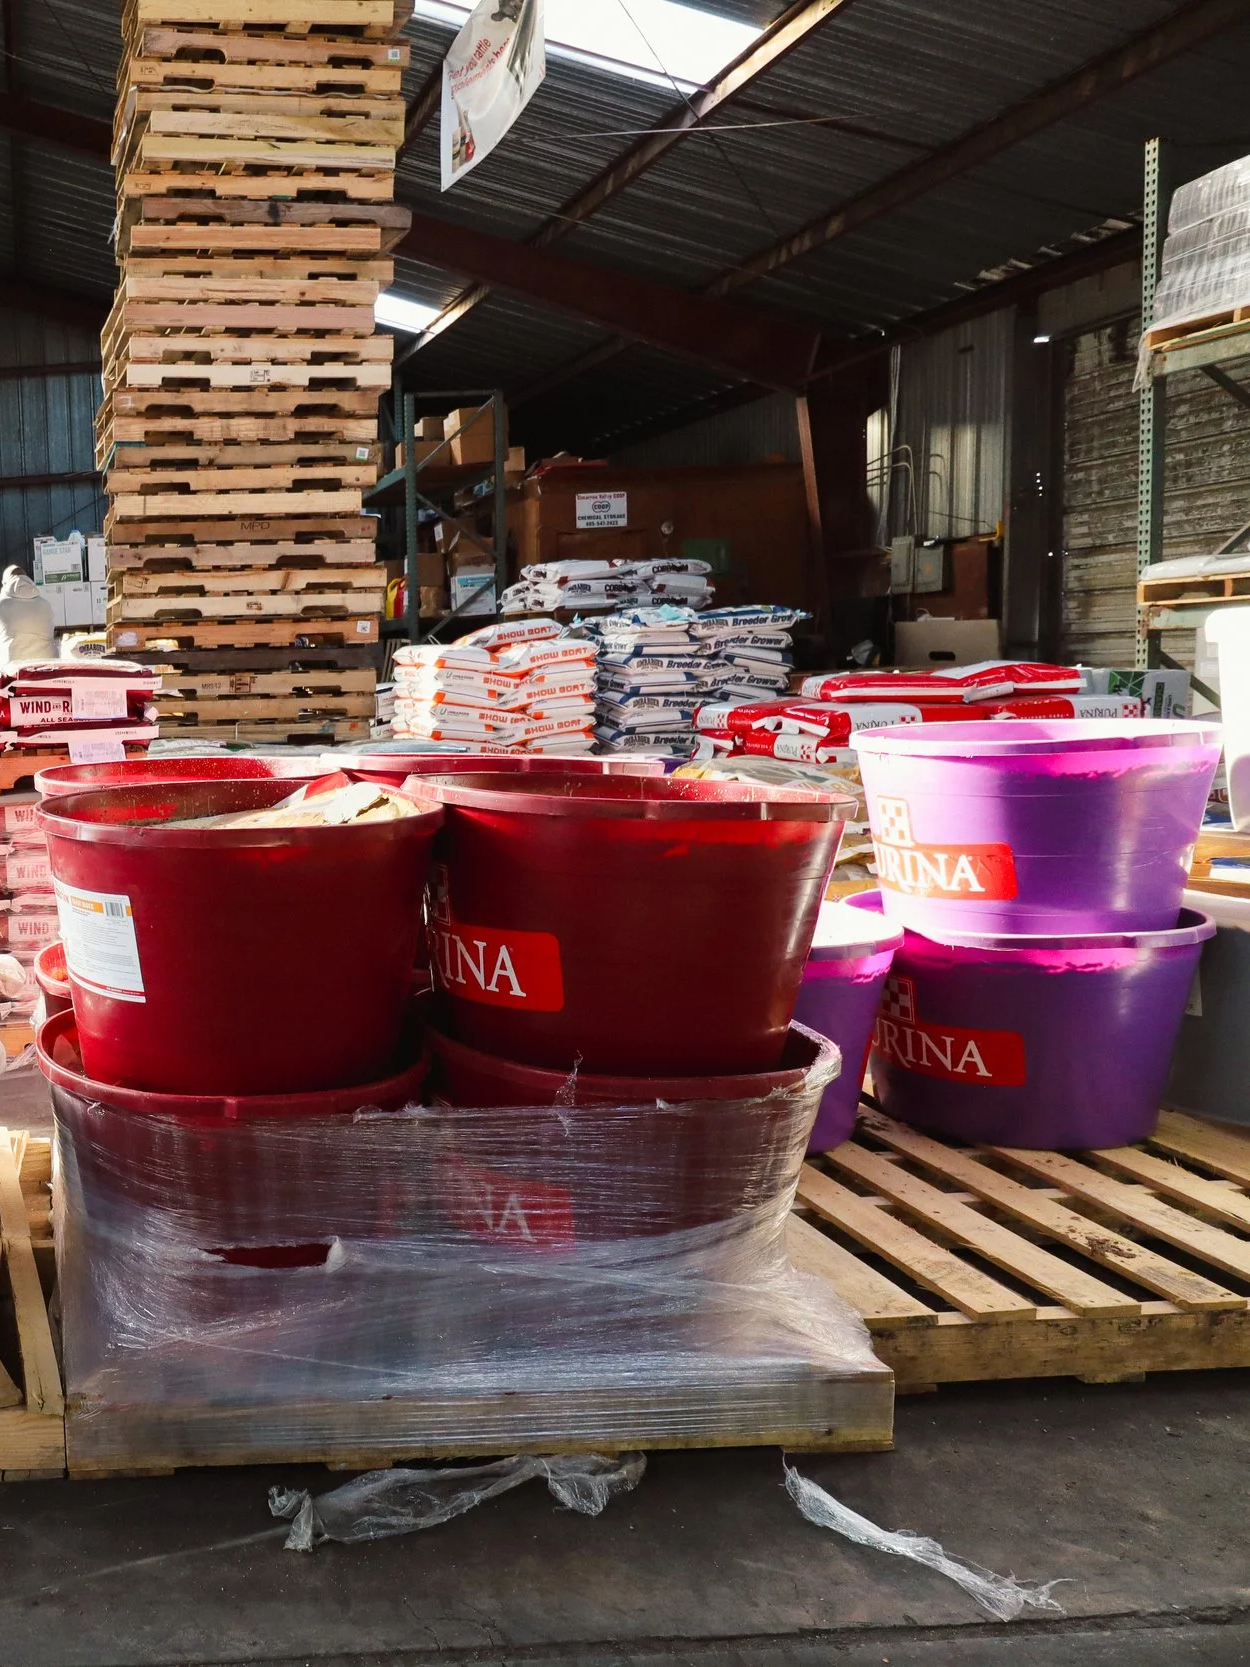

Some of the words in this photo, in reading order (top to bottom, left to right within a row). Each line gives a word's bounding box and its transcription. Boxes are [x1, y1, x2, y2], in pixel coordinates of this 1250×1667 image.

[732, 616, 768, 627] Breeder
[497, 629, 525, 641] SHOW
[528, 625, 552, 636] GOAT
[751, 636, 784, 646] Grower
[530, 651, 558, 663] SHOW
[561, 646, 588, 657] GOAT
[666, 659, 701, 669] Breeder
[483, 676, 511, 689] SHOW
[747, 675, 779, 687] Grower
[526, 686, 556, 699] SHOW
[559, 683, 586, 693] GOAT
[20, 700, 52, 714] WIND
[662, 698, 697, 709] Breeder
[479, 712, 507, 724] SHOW
[1080, 706, 1117, 718] PURINA
[524, 722, 554, 735] SHOW
[557, 719, 581, 729] GOAT
[653, 735, 690, 746] Breeder
[16, 864, 48, 879] WIND
[876, 849, 985, 893] URINA
[18, 922, 49, 936] WIND
[872, 1017, 993, 1078] URINA
